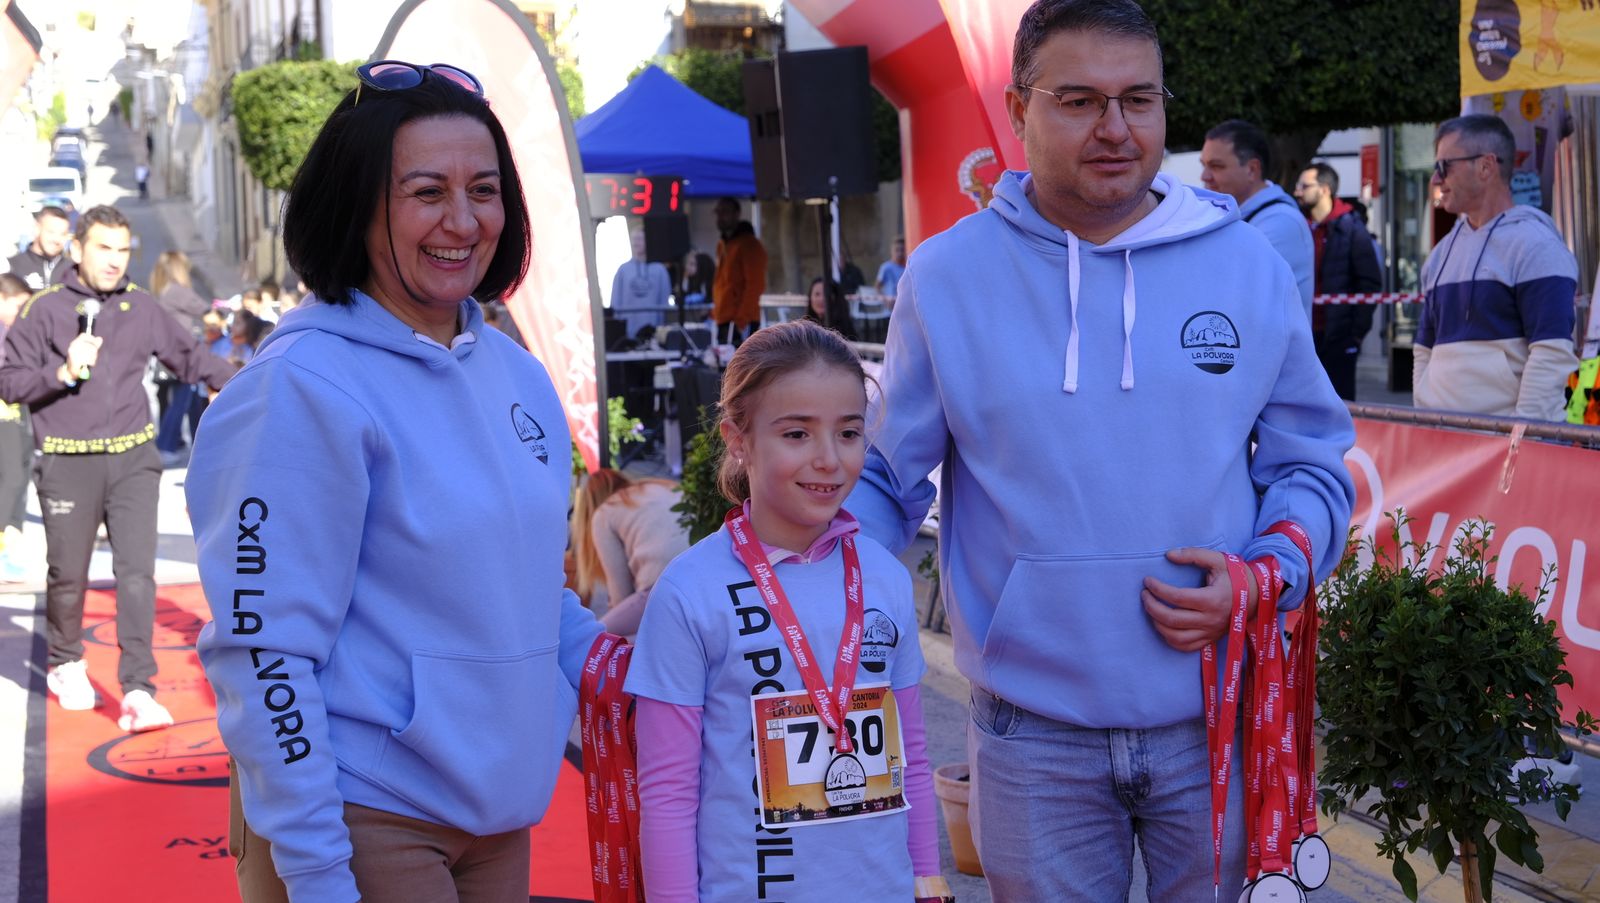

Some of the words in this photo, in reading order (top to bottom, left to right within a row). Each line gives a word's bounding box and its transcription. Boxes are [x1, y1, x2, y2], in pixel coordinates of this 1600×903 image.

[1204, 352, 1234, 360] POLVORA
[236, 497, 268, 575] Cxm
[232, 589, 264, 636] LA
[726, 581, 772, 636] LA
[772, 707, 784, 718] LA
[852, 692, 880, 702] CANTORIA
